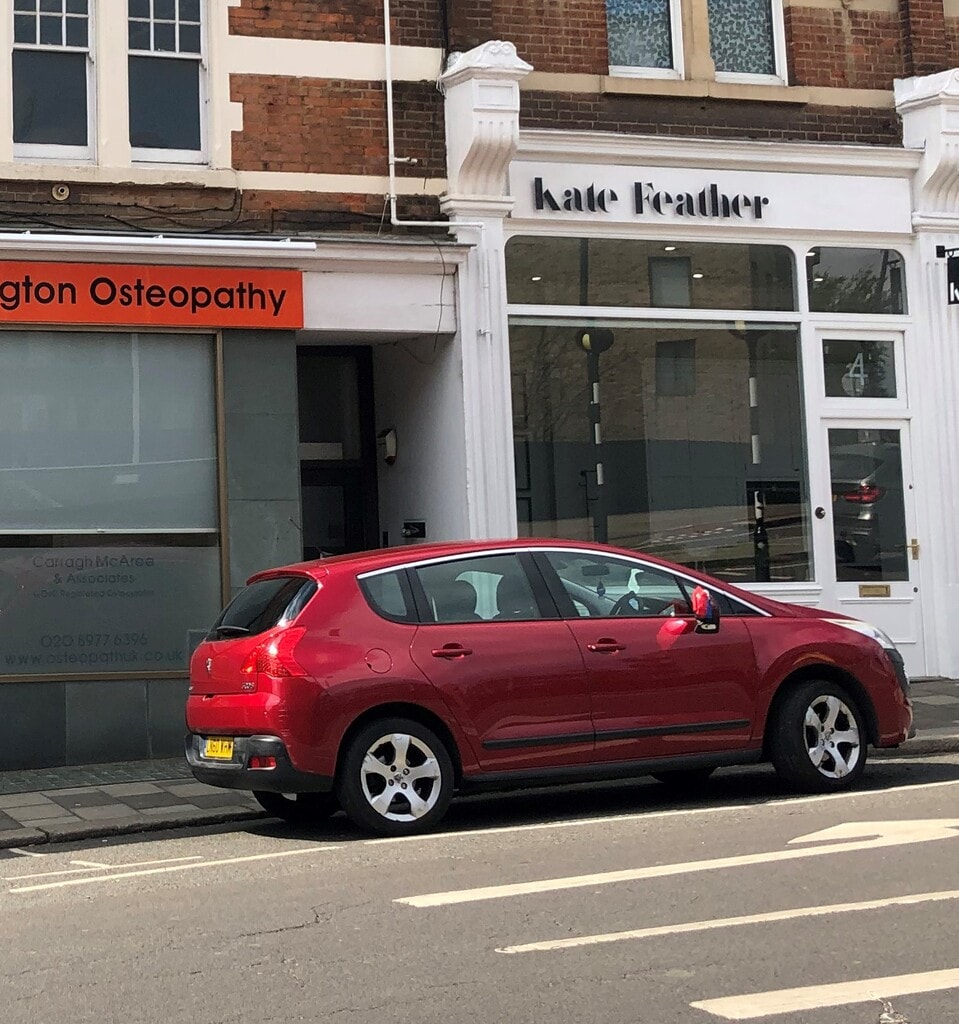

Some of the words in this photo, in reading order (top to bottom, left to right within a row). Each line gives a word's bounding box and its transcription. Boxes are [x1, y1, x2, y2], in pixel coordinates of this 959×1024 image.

[634, 181, 769, 219] Feather
[89, 277, 287, 316] Osteopathy
[54, 573, 62, 584] &
[67, 572, 135, 584] Associates
[40, 634, 74, 647] 020
